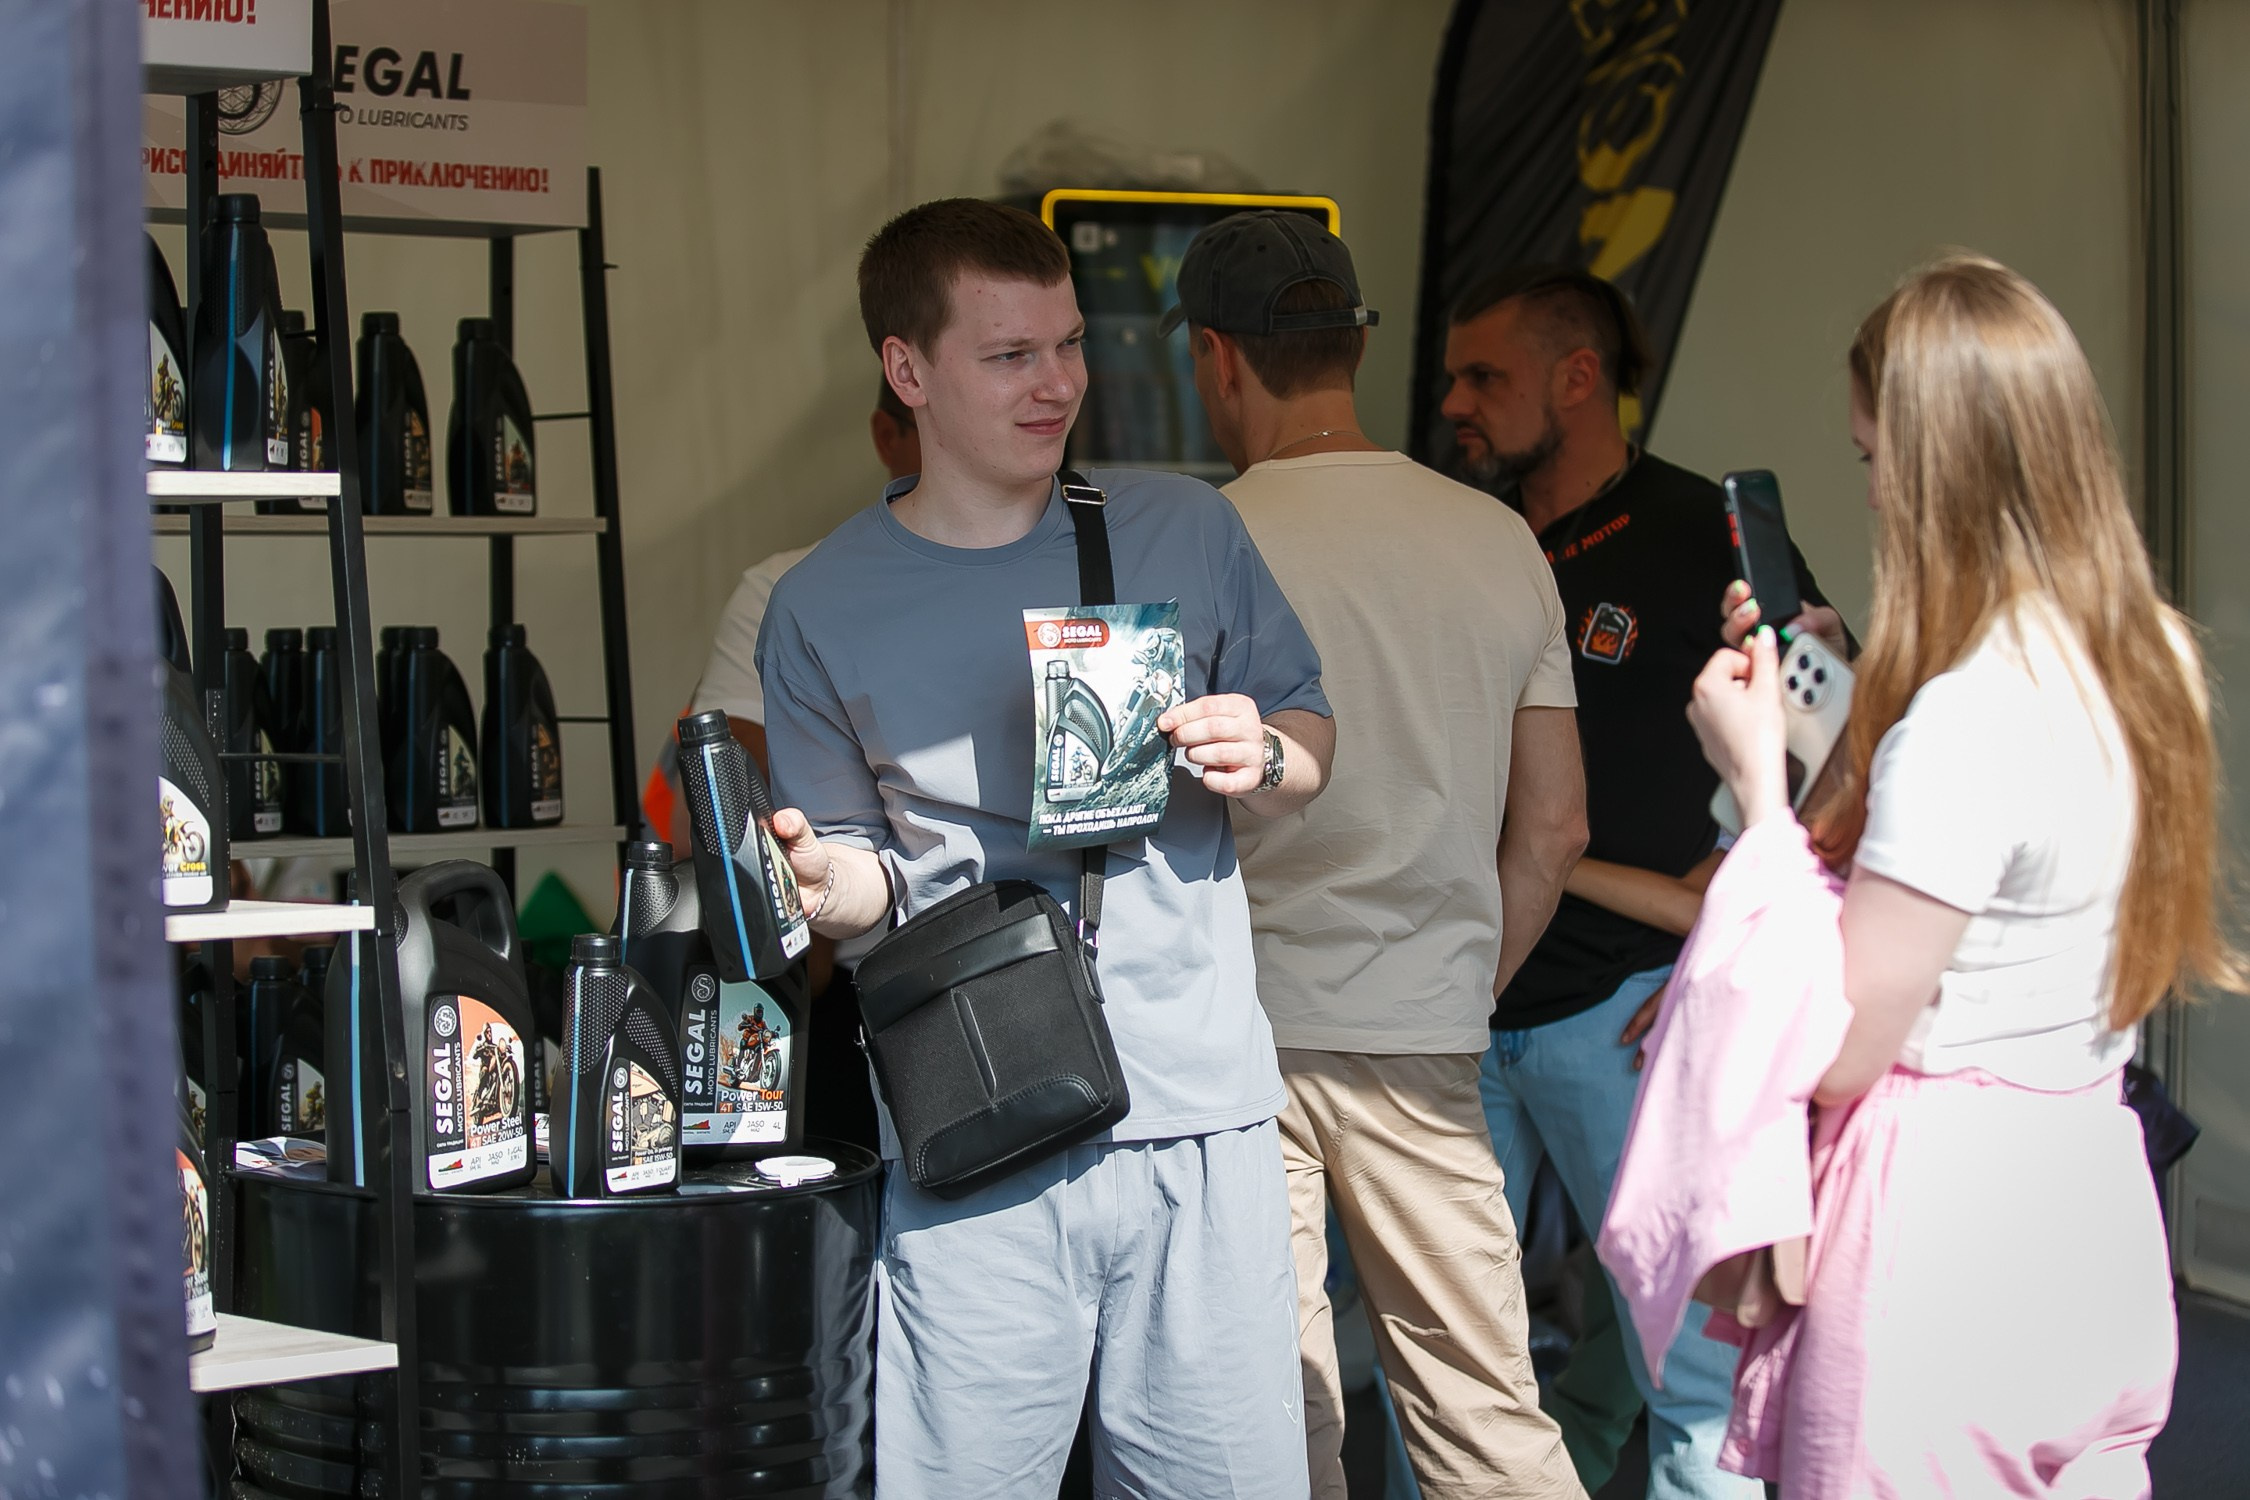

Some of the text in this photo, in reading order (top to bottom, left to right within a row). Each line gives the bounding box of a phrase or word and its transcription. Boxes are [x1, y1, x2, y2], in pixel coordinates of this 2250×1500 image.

[333, 44, 471, 100] EGAL
[357, 108, 469, 131] LUBRICANTS
[349, 158, 364, 184] К
[369, 158, 550, 193] ПРИКЛЮЧЕНИЮ!
[300, 431, 308, 472] EGAL
[1062, 625, 1103, 638] SEGAL
[685, 1009, 706, 1095] SEGAL
[707, 1009, 718, 1095] MOTO LUBRICANTS
[434, 1042, 454, 1135] SEGAL
[453, 1041, 464, 1133] MOTO LUBRICANTS
[721, 1089, 784, 1102] Power Tour
[281, 1083, 292, 1132] SEGAL
[720, 1101, 783, 1113] 4T SAE 15W-50
[470, 1111, 523, 1137] Power Steel
[612, 1091, 623, 1153] SEGAL
[724, 1121, 737, 1129] API
[773, 1121, 781, 1129] 4L
[481, 1133, 497, 1146] SAE
[497, 1126, 524, 1142] 20W-50
[488, 1151, 503, 1161] JASO
[643, 1155, 654, 1163] SAE
